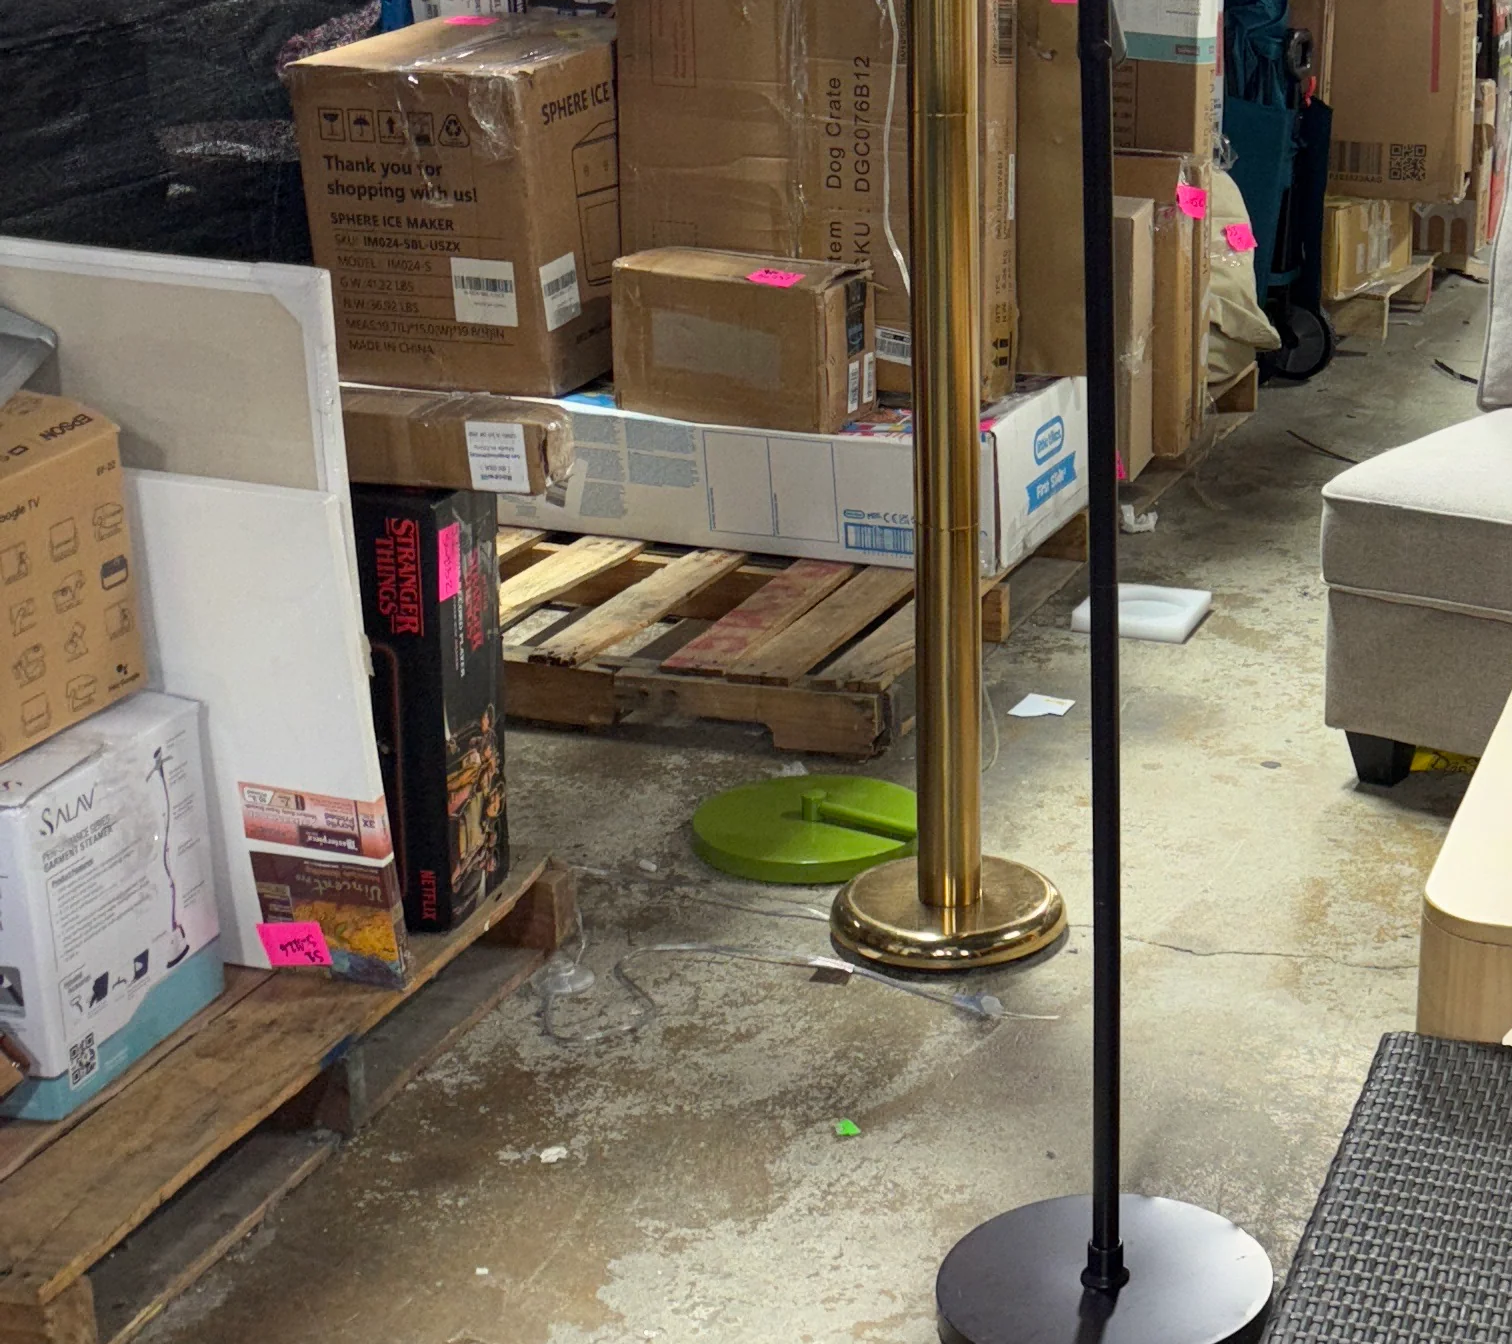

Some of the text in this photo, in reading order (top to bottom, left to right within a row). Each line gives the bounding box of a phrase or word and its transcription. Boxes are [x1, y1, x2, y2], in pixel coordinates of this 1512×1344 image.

[541, 81, 611, 126] SPHERE ICE
[854, 55, 871, 193] DGC076B12
[323, 155, 442, 179] Thank you for
[327, 179, 478, 203] shopping with us!
[826, 77, 846, 262] tem Dog Crate
[330, 212, 455, 231] SPHERE ICE MAKER
[39, 413, 94, 441] EPSON
[375, 537, 399, 618] THINGS
[390, 518, 424, 636] STRANGER
[420, 869, 437, 921] NETFLIX
